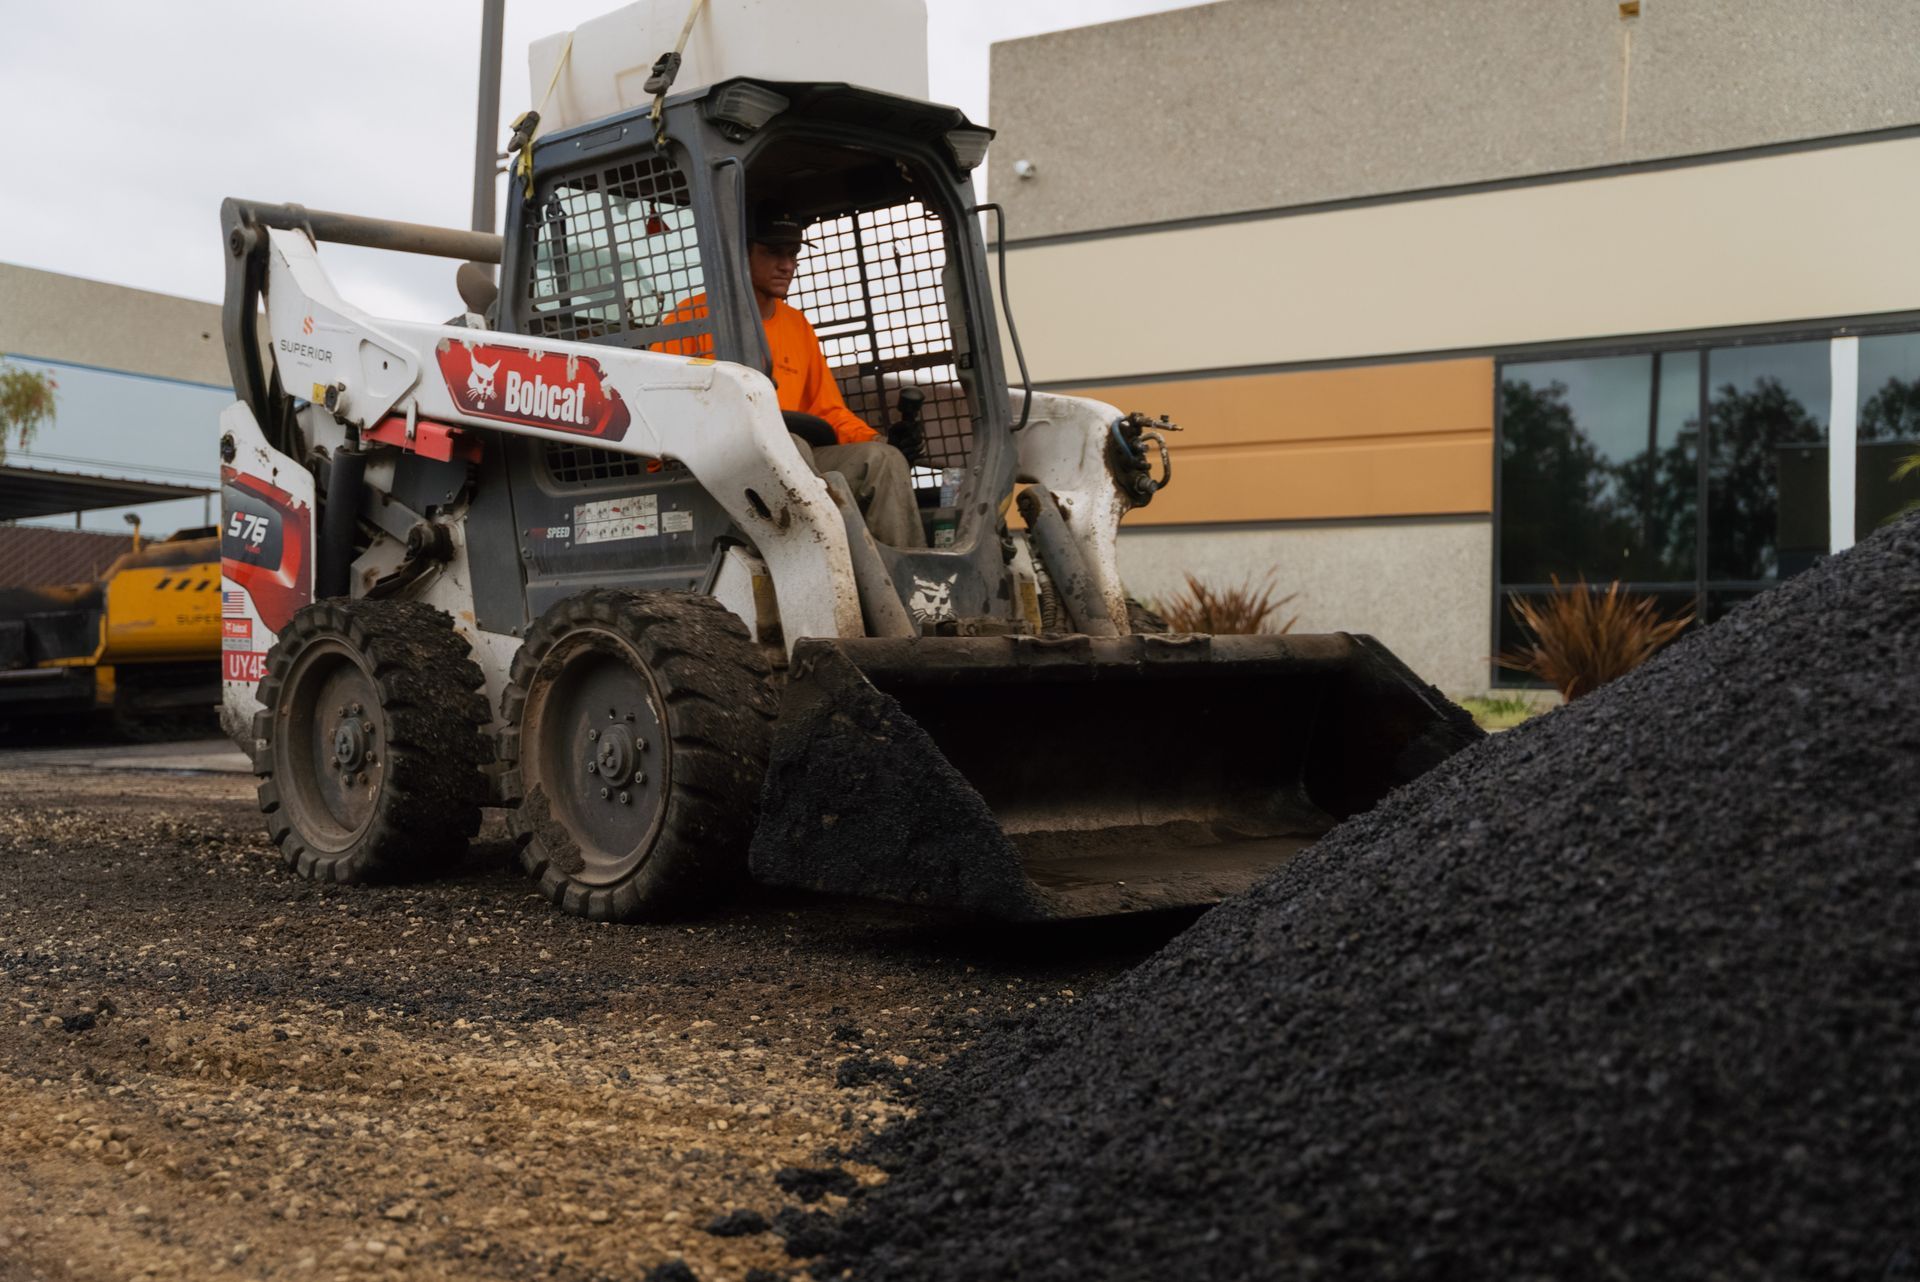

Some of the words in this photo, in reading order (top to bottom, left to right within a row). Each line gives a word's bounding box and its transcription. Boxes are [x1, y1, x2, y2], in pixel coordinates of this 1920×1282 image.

[280, 339, 333, 364] SUPERIOR
[505, 370, 586, 425] Bobcat
[228, 511, 269, 544] S76
[546, 526, 570, 539] SPEED
